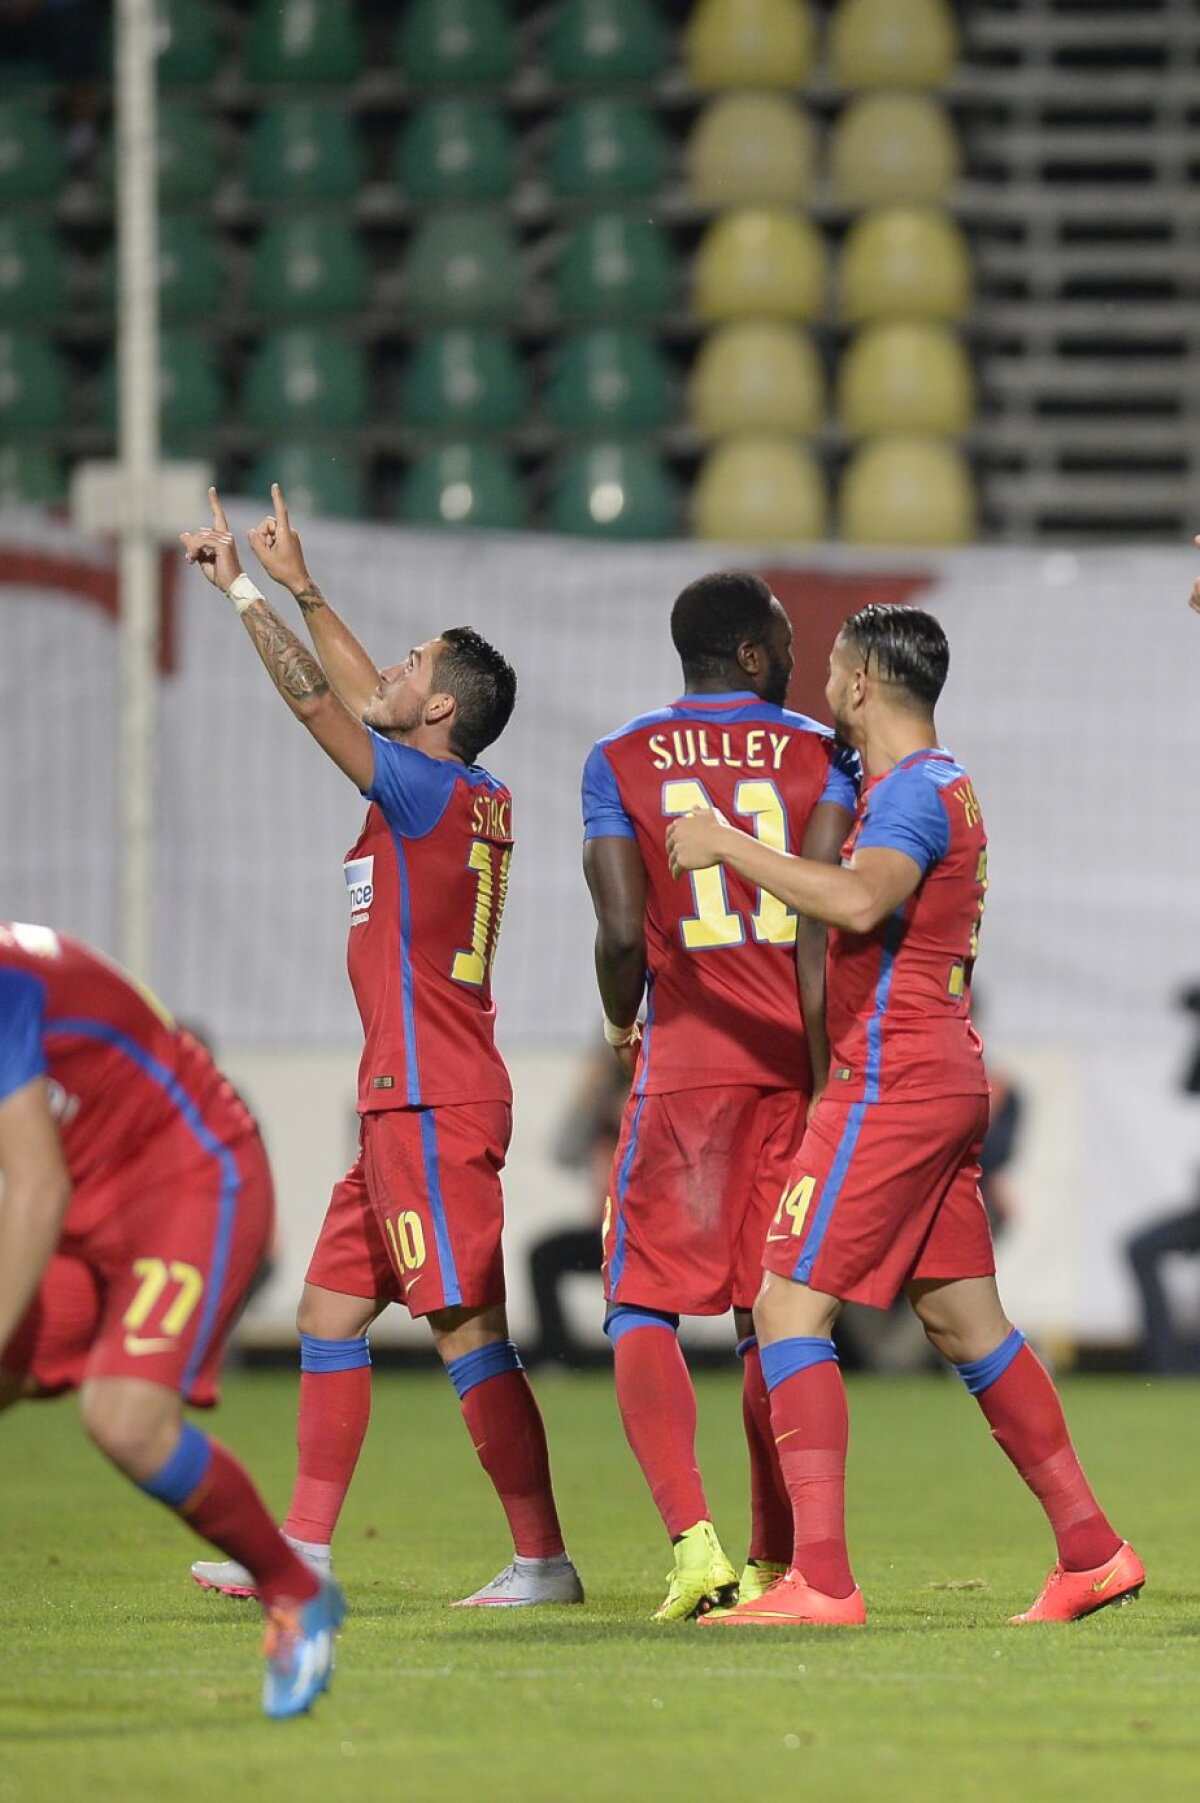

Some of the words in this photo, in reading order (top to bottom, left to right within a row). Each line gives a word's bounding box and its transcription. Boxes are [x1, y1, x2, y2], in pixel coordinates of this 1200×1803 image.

[649, 729, 791, 770] SULLEY
[661, 778, 798, 950] 11
[384, 1210, 426, 1275] 10
[122, 1257, 204, 1336] 77
